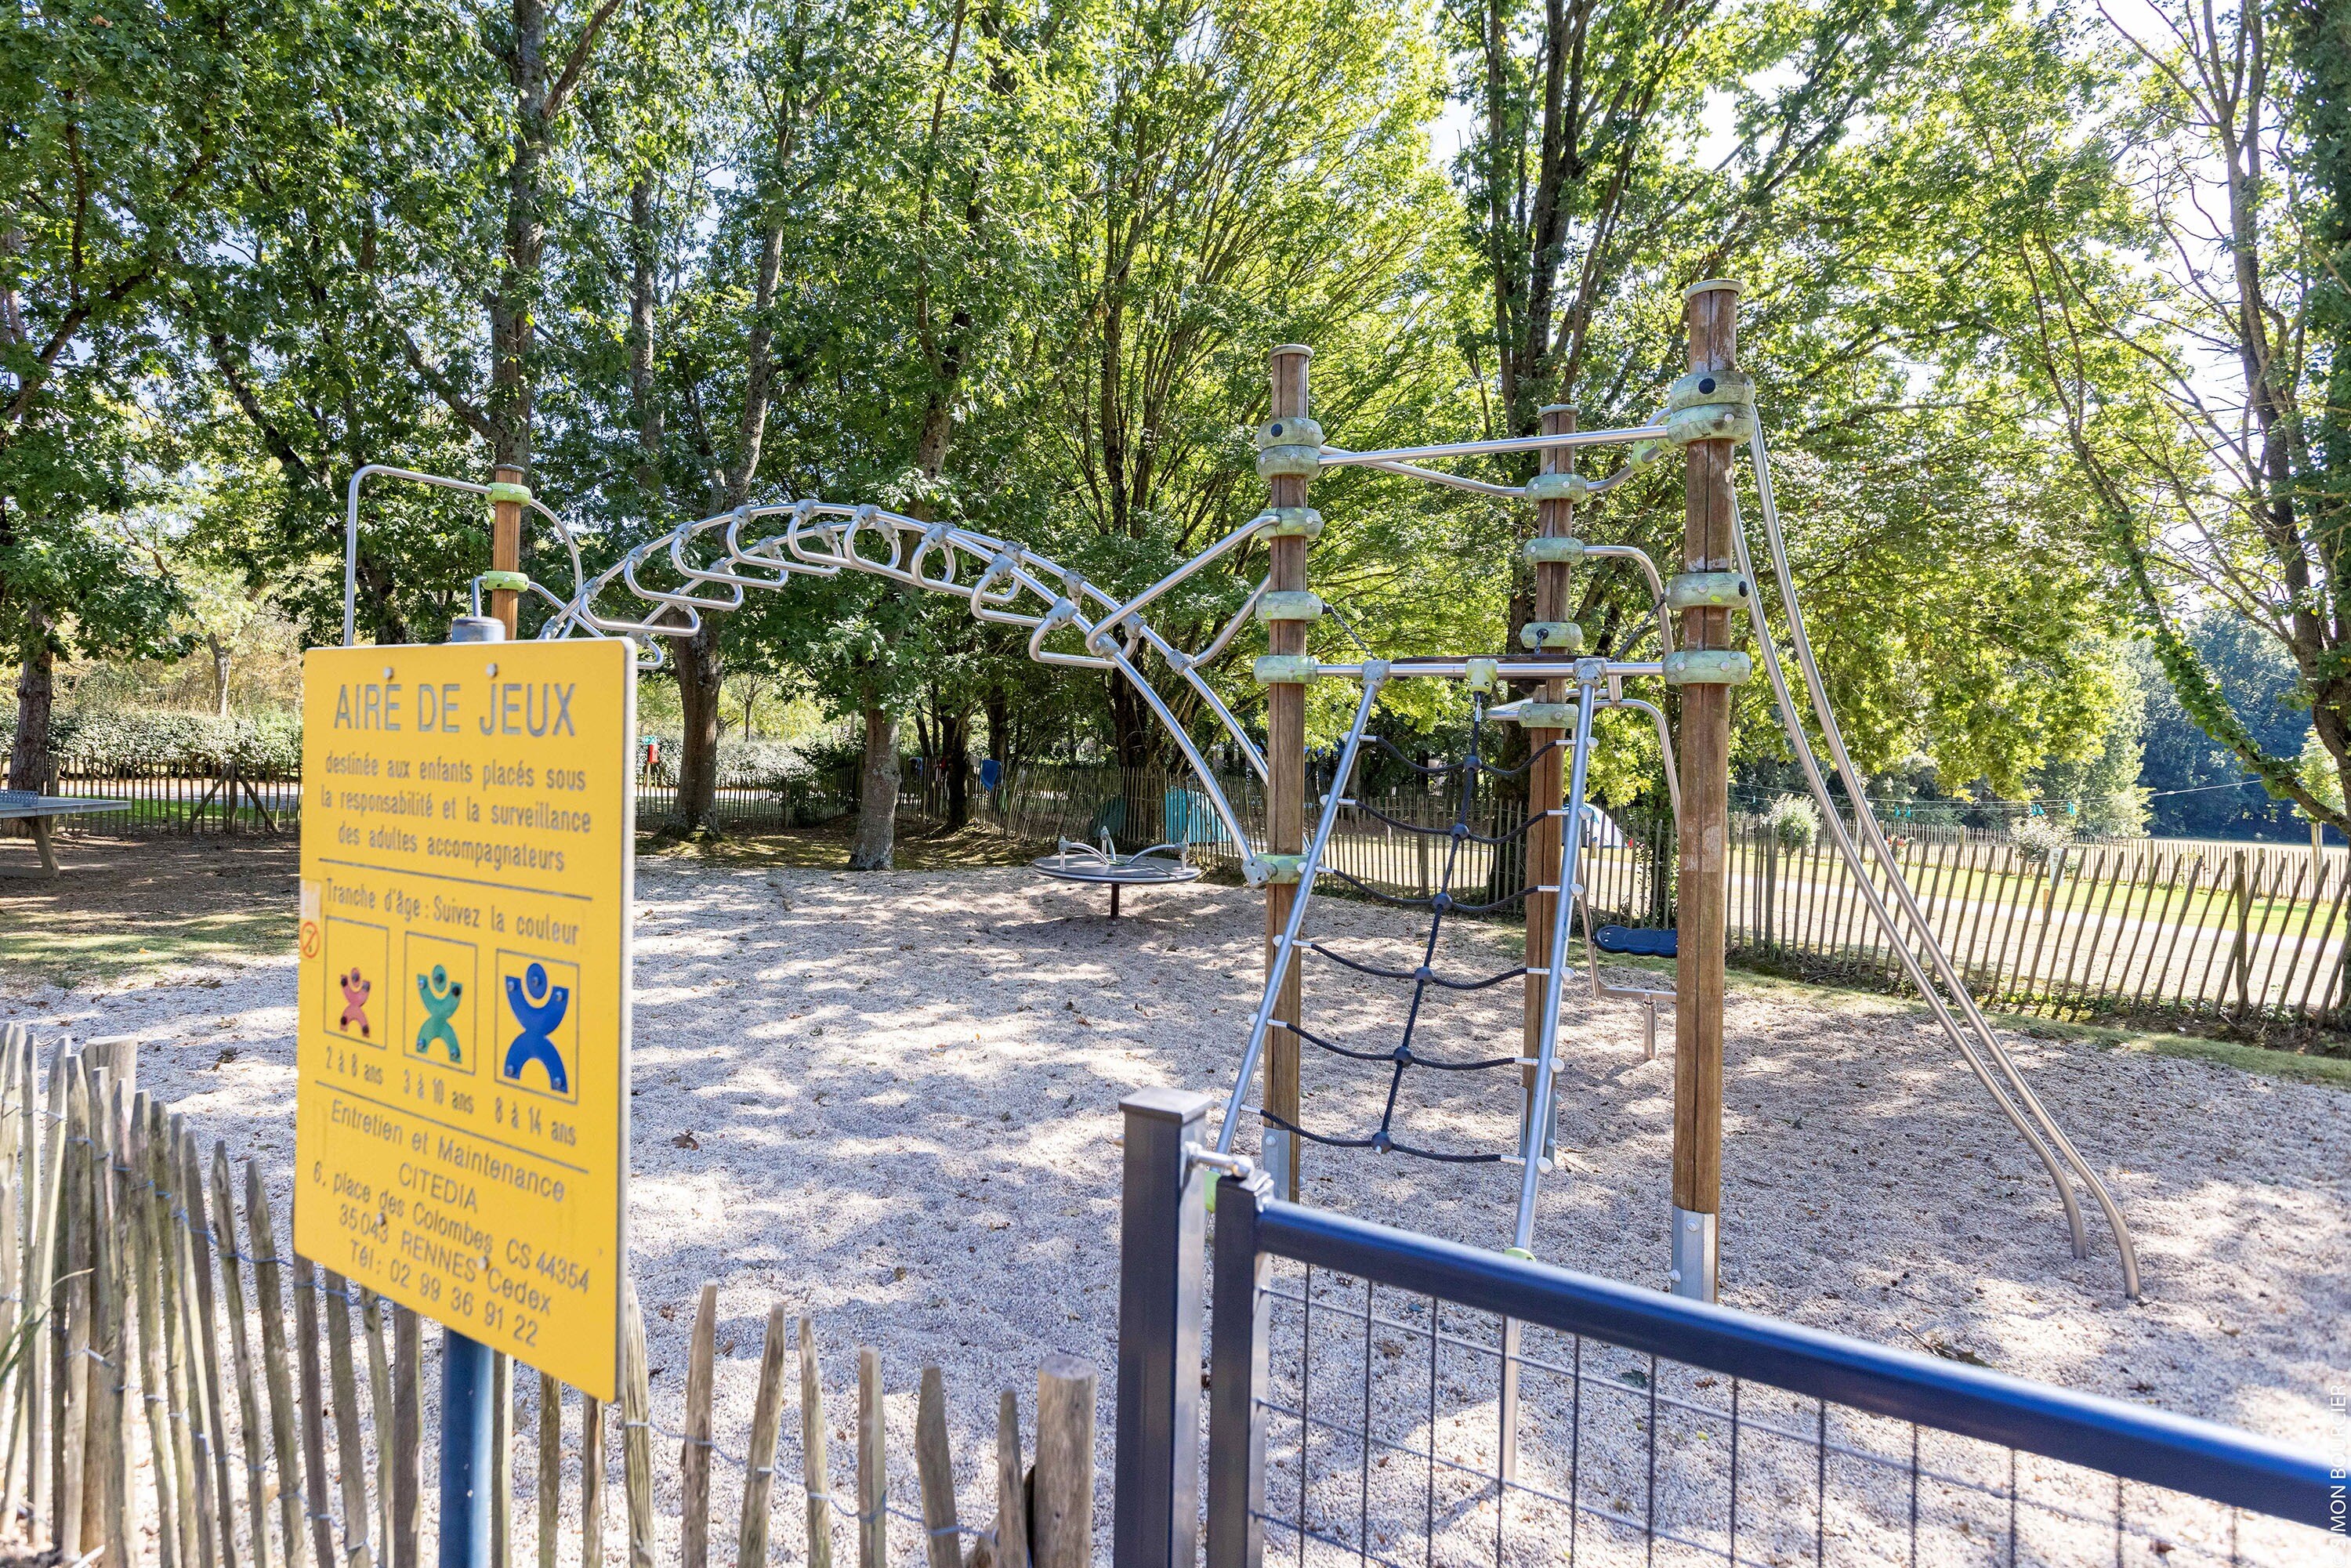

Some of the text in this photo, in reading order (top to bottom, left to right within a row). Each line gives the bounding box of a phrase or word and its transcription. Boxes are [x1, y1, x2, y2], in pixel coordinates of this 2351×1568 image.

[334, 683, 576, 738] AIRE DE JEUX
[326, 751, 586, 791] destinée aux enfants placés sous
[321, 784, 591, 834] la responsabilité et la surveillance
[339, 821, 565, 872] des adultes accompagnateurs
[326, 878, 376, 909] Tranche
[433, 895, 480, 928] Suivez
[491, 905, 505, 932] la
[516, 914, 579, 945] couleur
[326, 1045, 332, 1070] 2
[364, 1063, 383, 1085] ans
[404, 1069, 410, 1095] 3
[451, 1091, 474, 1115] ans
[494, 1096, 503, 1124] 8
[528, 1106, 542, 1136] 14
[551, 1121, 577, 1147] ans
[331, 1099, 565, 1202] Entretien et Maintenance
[399, 1162, 478, 1214] CITEDIA
[333, 1172, 371, 1203] place
[379, 1189, 404, 1218] des
[413, 1201, 493, 1257] Colombes
[506, 1238, 531, 1270] CS
[536, 1251, 589, 1295] 44354
[400, 1229, 476, 1283] RENNES
[487, 1261, 552, 1316] Cedex
[390, 1258, 411, 1288] 02
[451, 1287, 474, 1317] 36
[513, 1314, 538, 1348] 22
